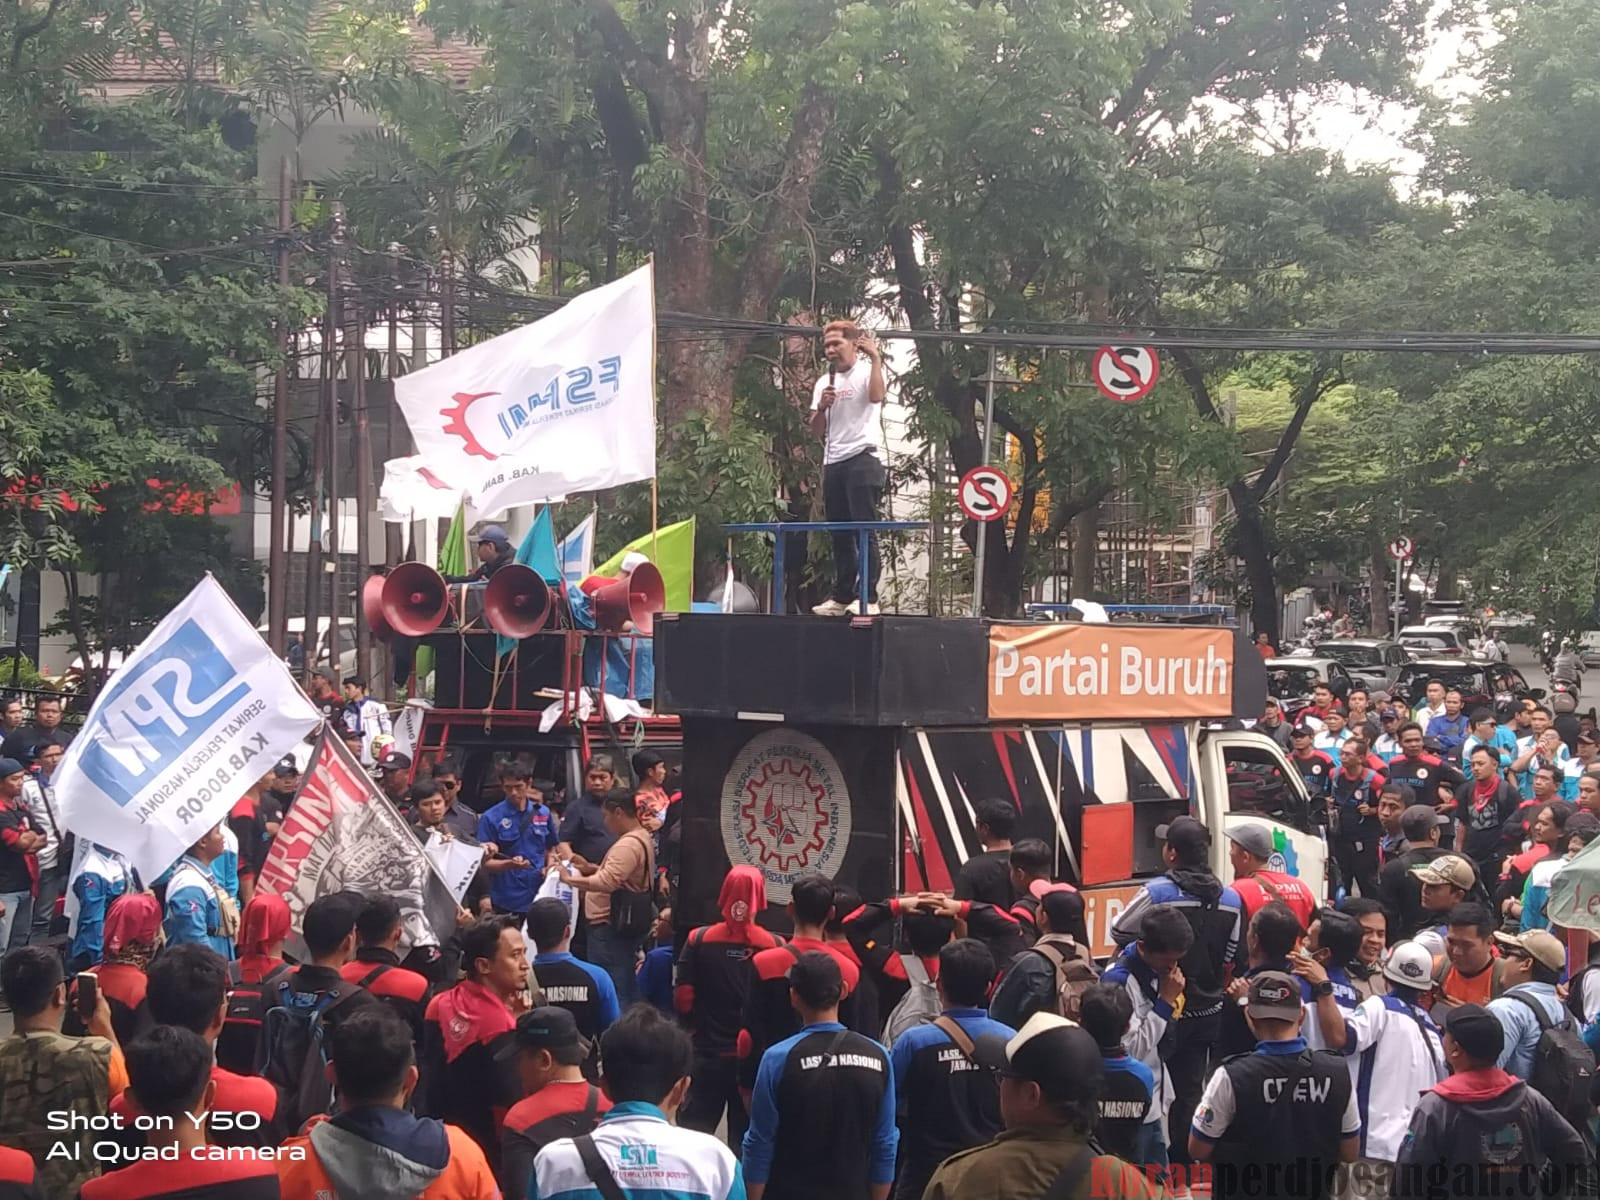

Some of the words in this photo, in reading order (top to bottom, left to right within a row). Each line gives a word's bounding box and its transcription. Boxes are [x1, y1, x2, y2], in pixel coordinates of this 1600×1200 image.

[994, 643, 1109, 696] Partai
[1120, 644, 1227, 696] Buruh
[814, 801, 839, 870] INDONESIA
[302, 847, 325, 881] MAY
[546, 986, 588, 1002] NASIONAL
[839, 1054, 882, 1072] NASIONAL
